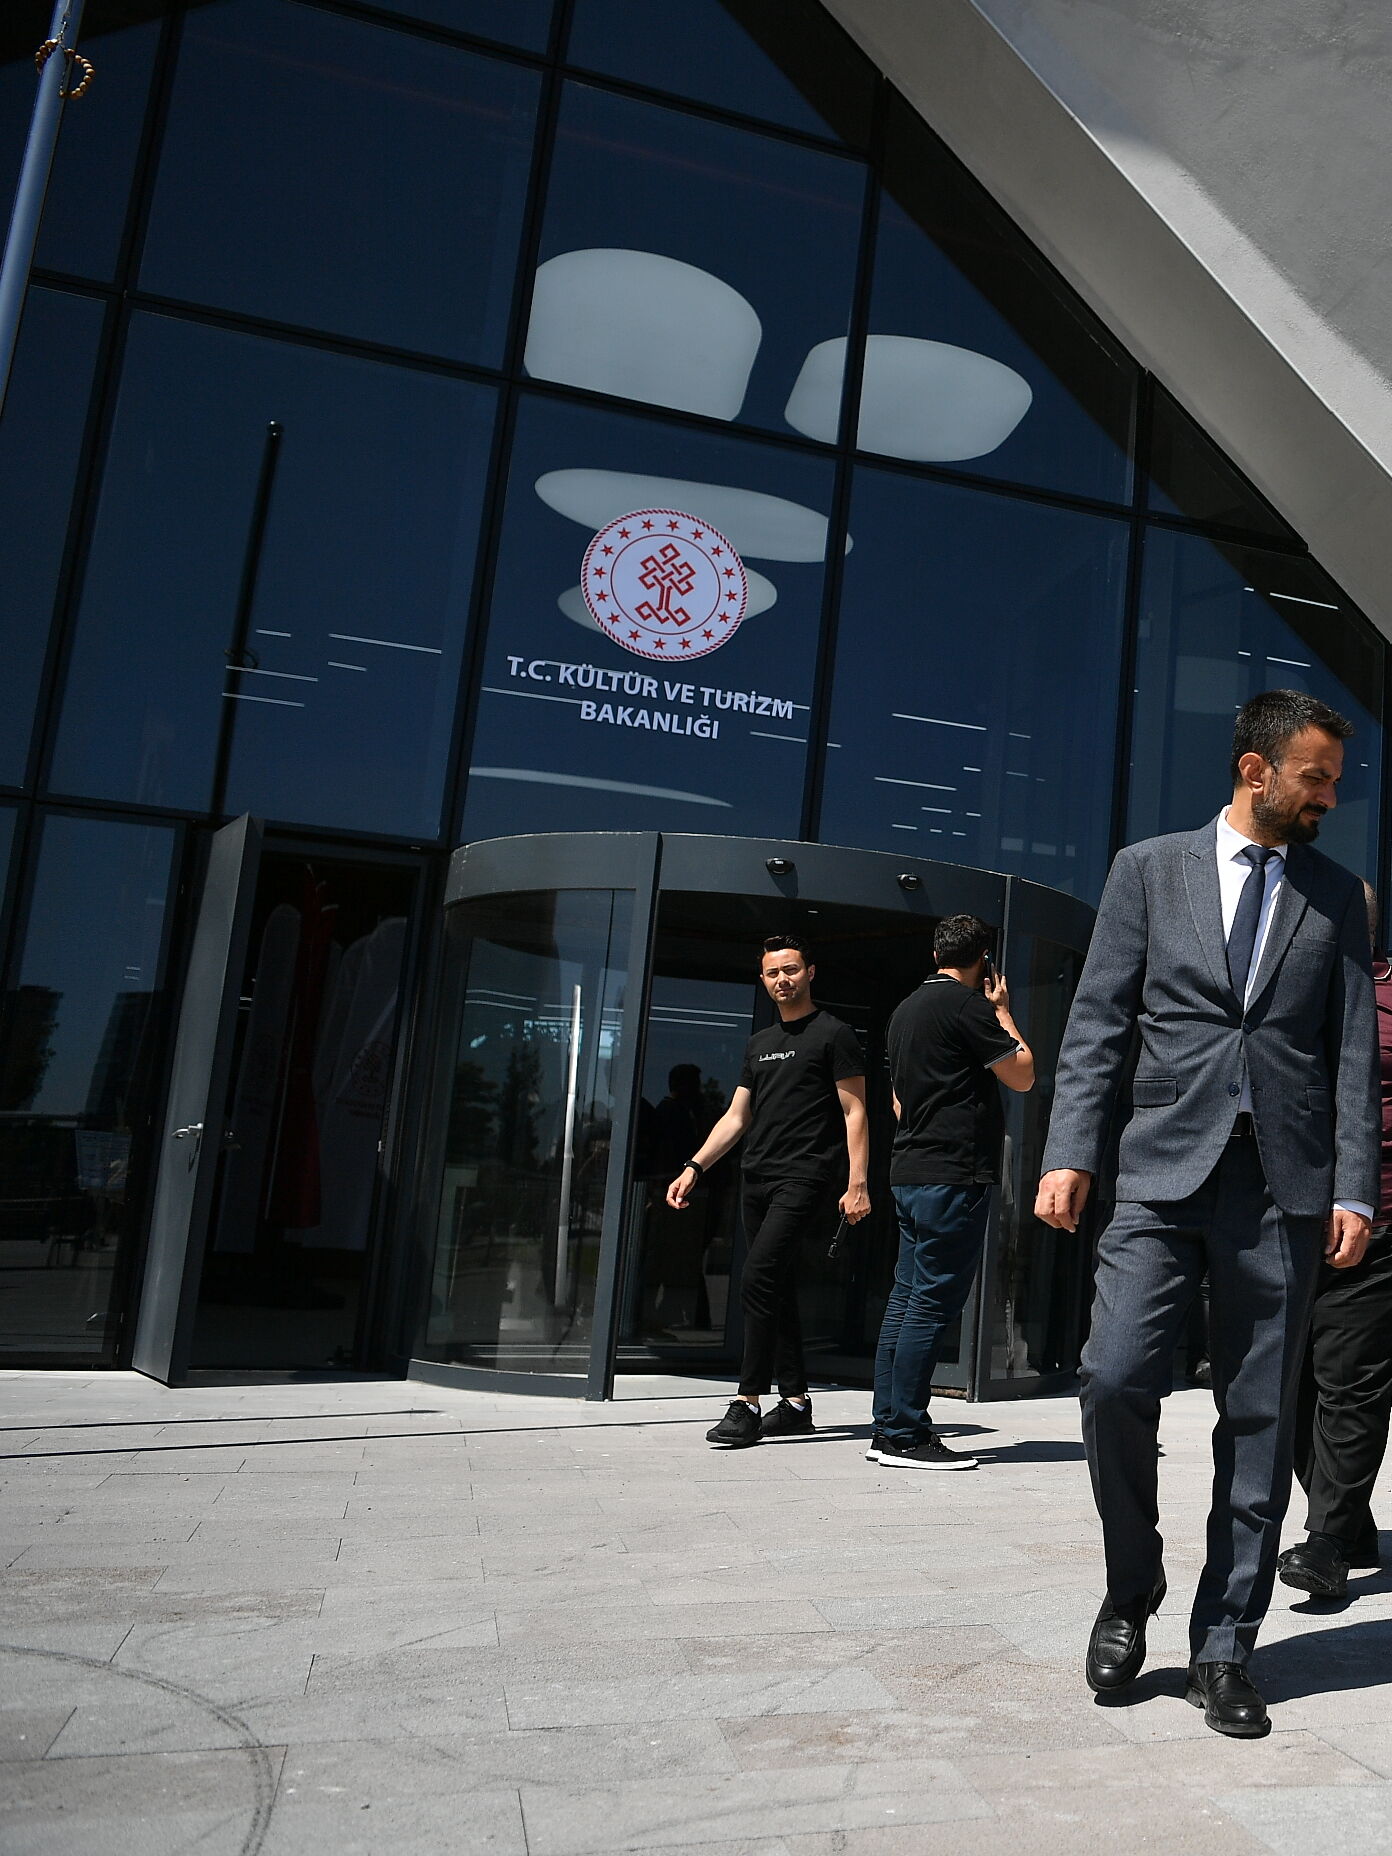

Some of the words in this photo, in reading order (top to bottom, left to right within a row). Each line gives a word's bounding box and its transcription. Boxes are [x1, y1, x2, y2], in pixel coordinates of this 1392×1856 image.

[507, 656, 551, 681] T.C.
[558, 663, 658, 698] KÜLTÜR
[663, 681, 694, 704] VE
[700, 687, 793, 719] TURİZM
[580, 701, 719, 739] BAKANLIĞI
